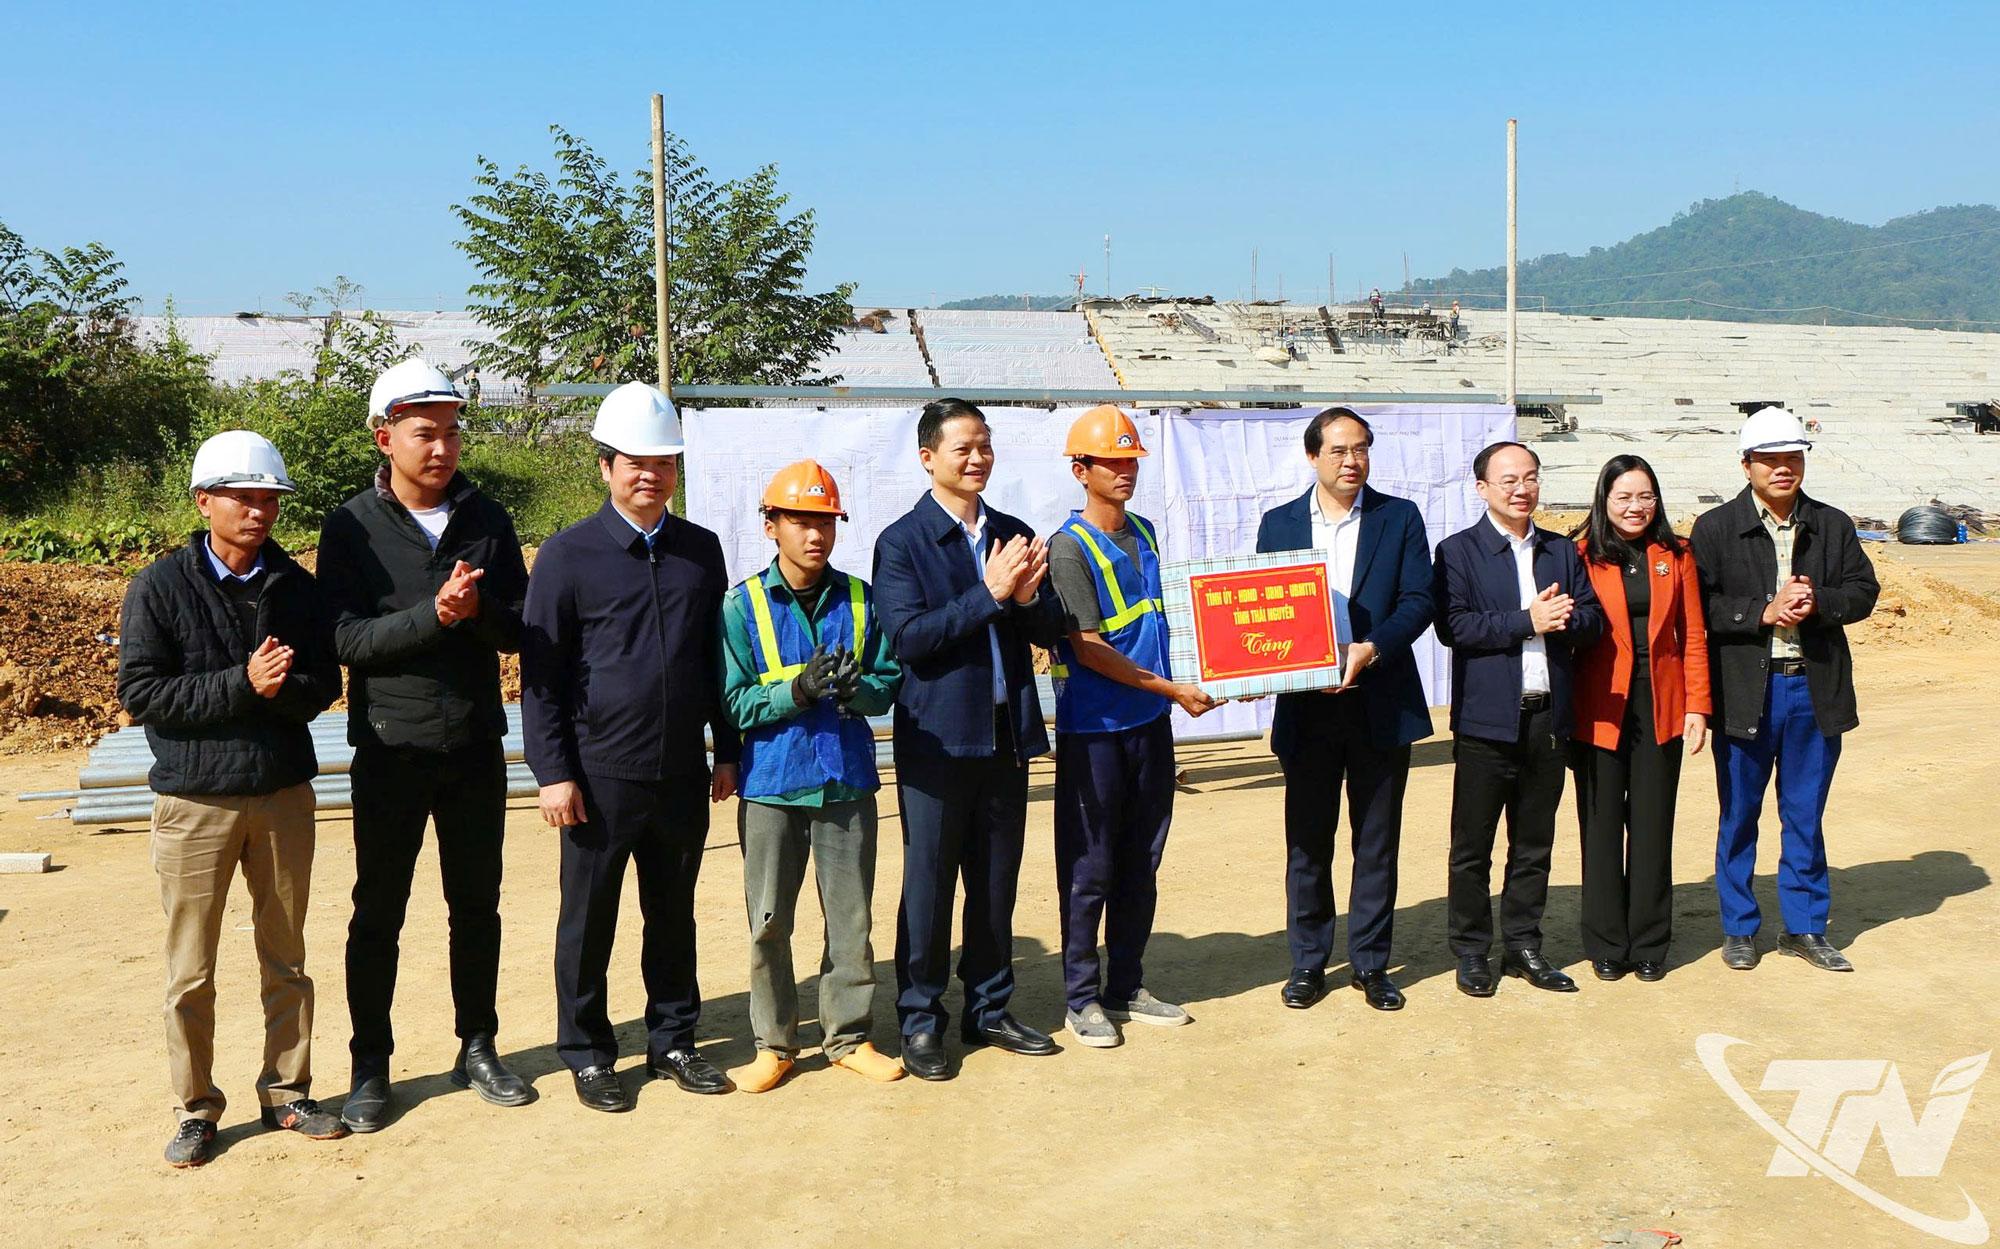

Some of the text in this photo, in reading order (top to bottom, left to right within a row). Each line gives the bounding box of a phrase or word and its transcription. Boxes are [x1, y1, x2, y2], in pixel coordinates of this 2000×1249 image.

[1250, 605, 1267, 624] THÁI
[1267, 603, 1296, 622] NGUYÊN
[1240, 631, 1293, 661] Tặng
